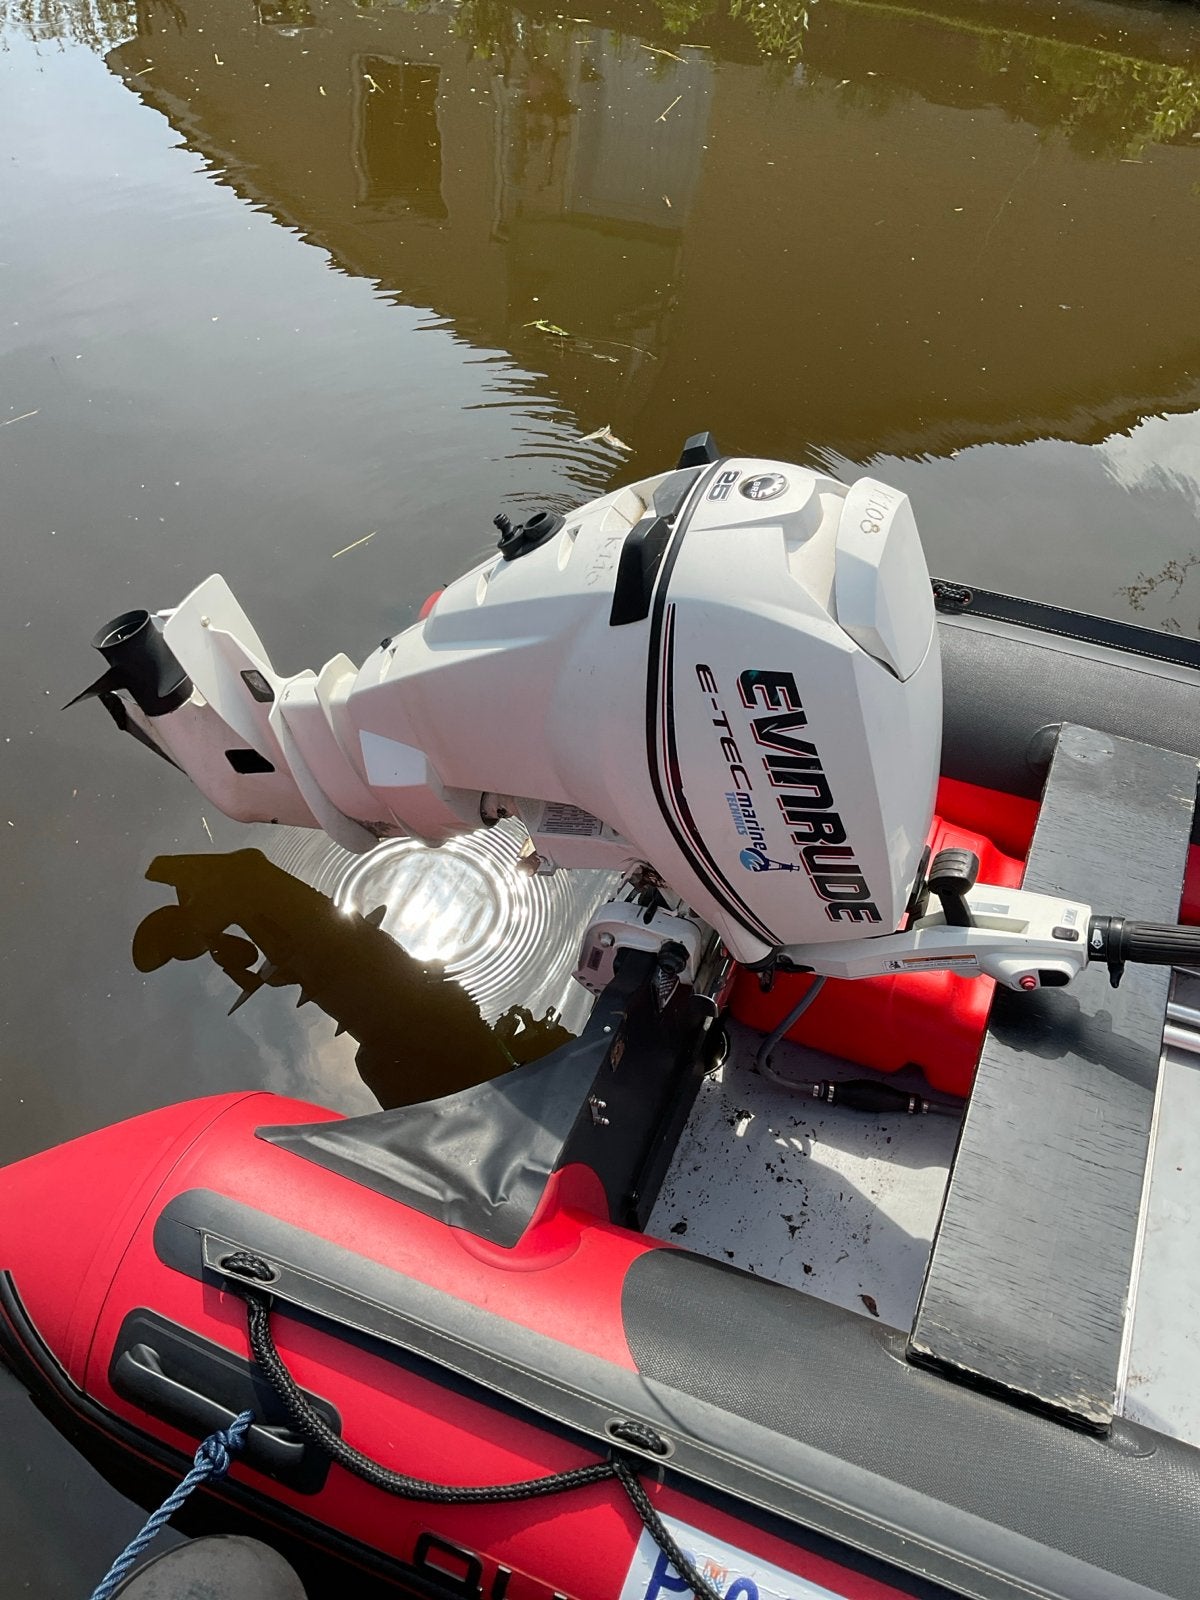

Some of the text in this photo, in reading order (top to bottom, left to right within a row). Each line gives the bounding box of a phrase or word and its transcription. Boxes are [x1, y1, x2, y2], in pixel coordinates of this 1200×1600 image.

[707, 470, 741, 501] 25
[749, 481, 762, 498] BRP
[695, 663, 752, 791] E-TEC
[724, 792, 749, 836] TECHNICS
[736, 669, 883, 923] EVINRUDE
[736, 792, 767, 851] marine
